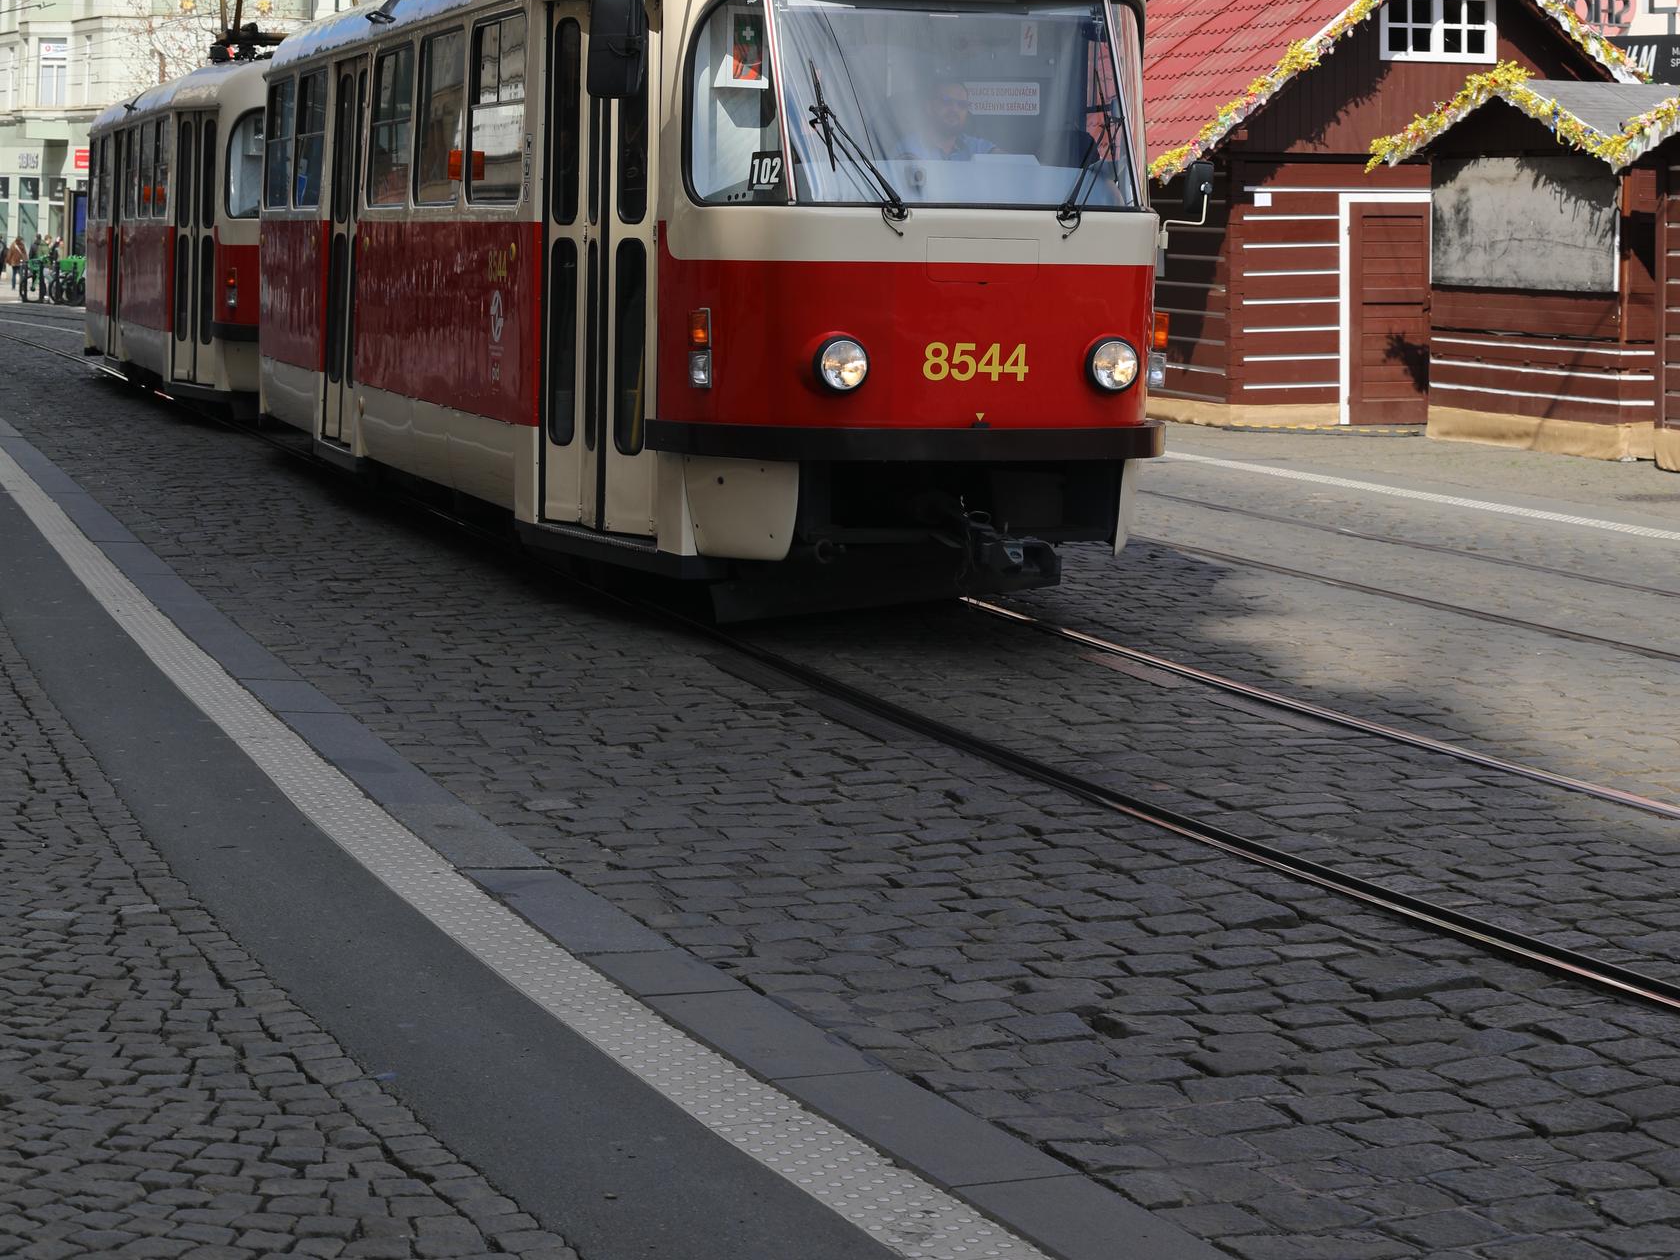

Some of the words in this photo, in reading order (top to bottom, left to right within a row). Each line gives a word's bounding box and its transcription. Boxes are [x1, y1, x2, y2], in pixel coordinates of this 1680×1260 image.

[752, 156, 782, 184] 102
[488, 250, 508, 283] 8544
[922, 341, 1029, 382] 8544
